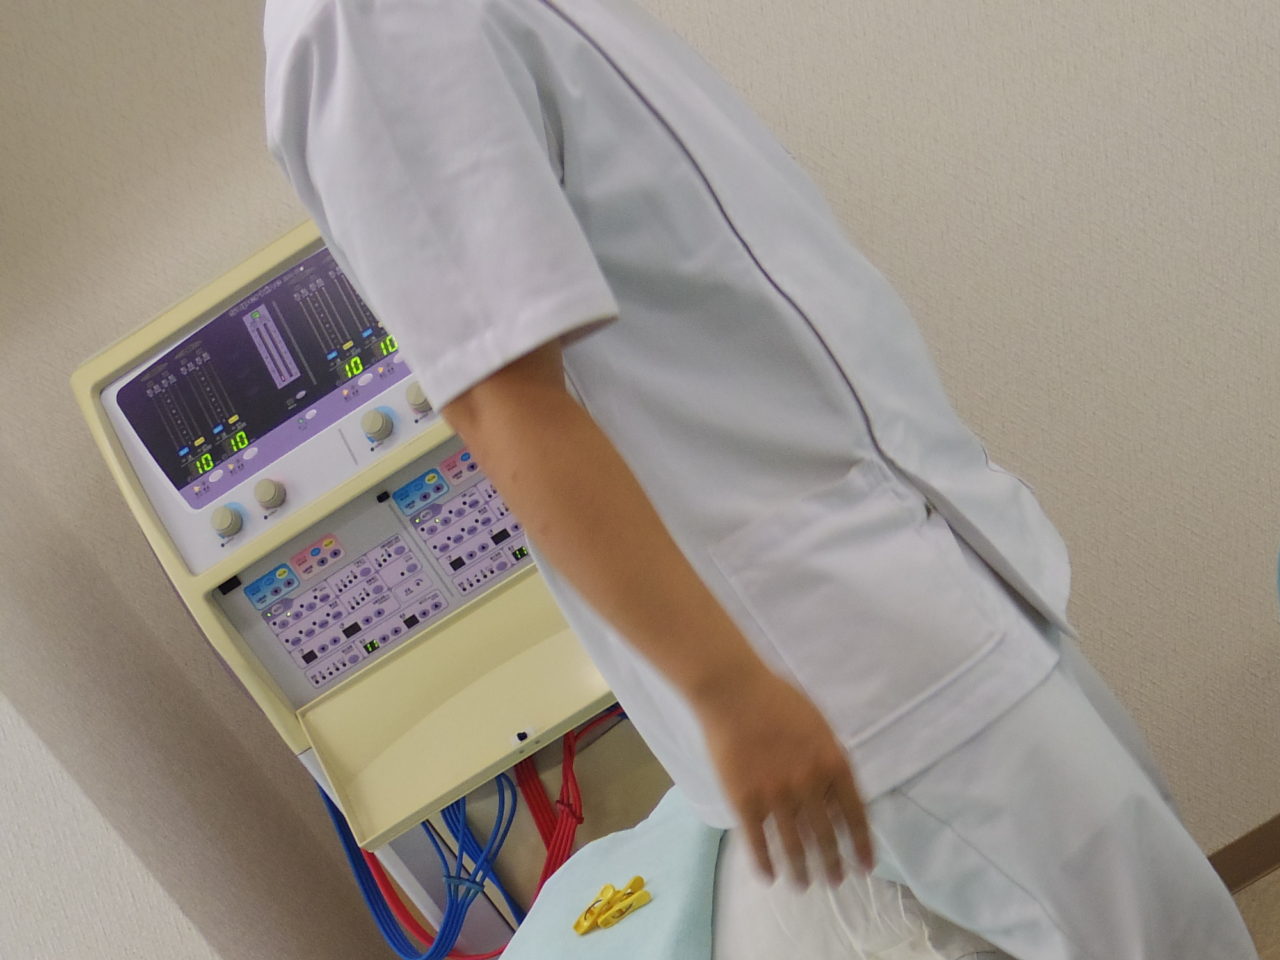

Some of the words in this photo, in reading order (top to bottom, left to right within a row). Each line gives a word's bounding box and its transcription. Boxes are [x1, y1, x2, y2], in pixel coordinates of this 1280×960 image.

[381, 334, 398, 355] 10
[345, 356, 363, 378] 10
[231, 431, 249, 452] 10
[196, 453, 214, 474] 10
